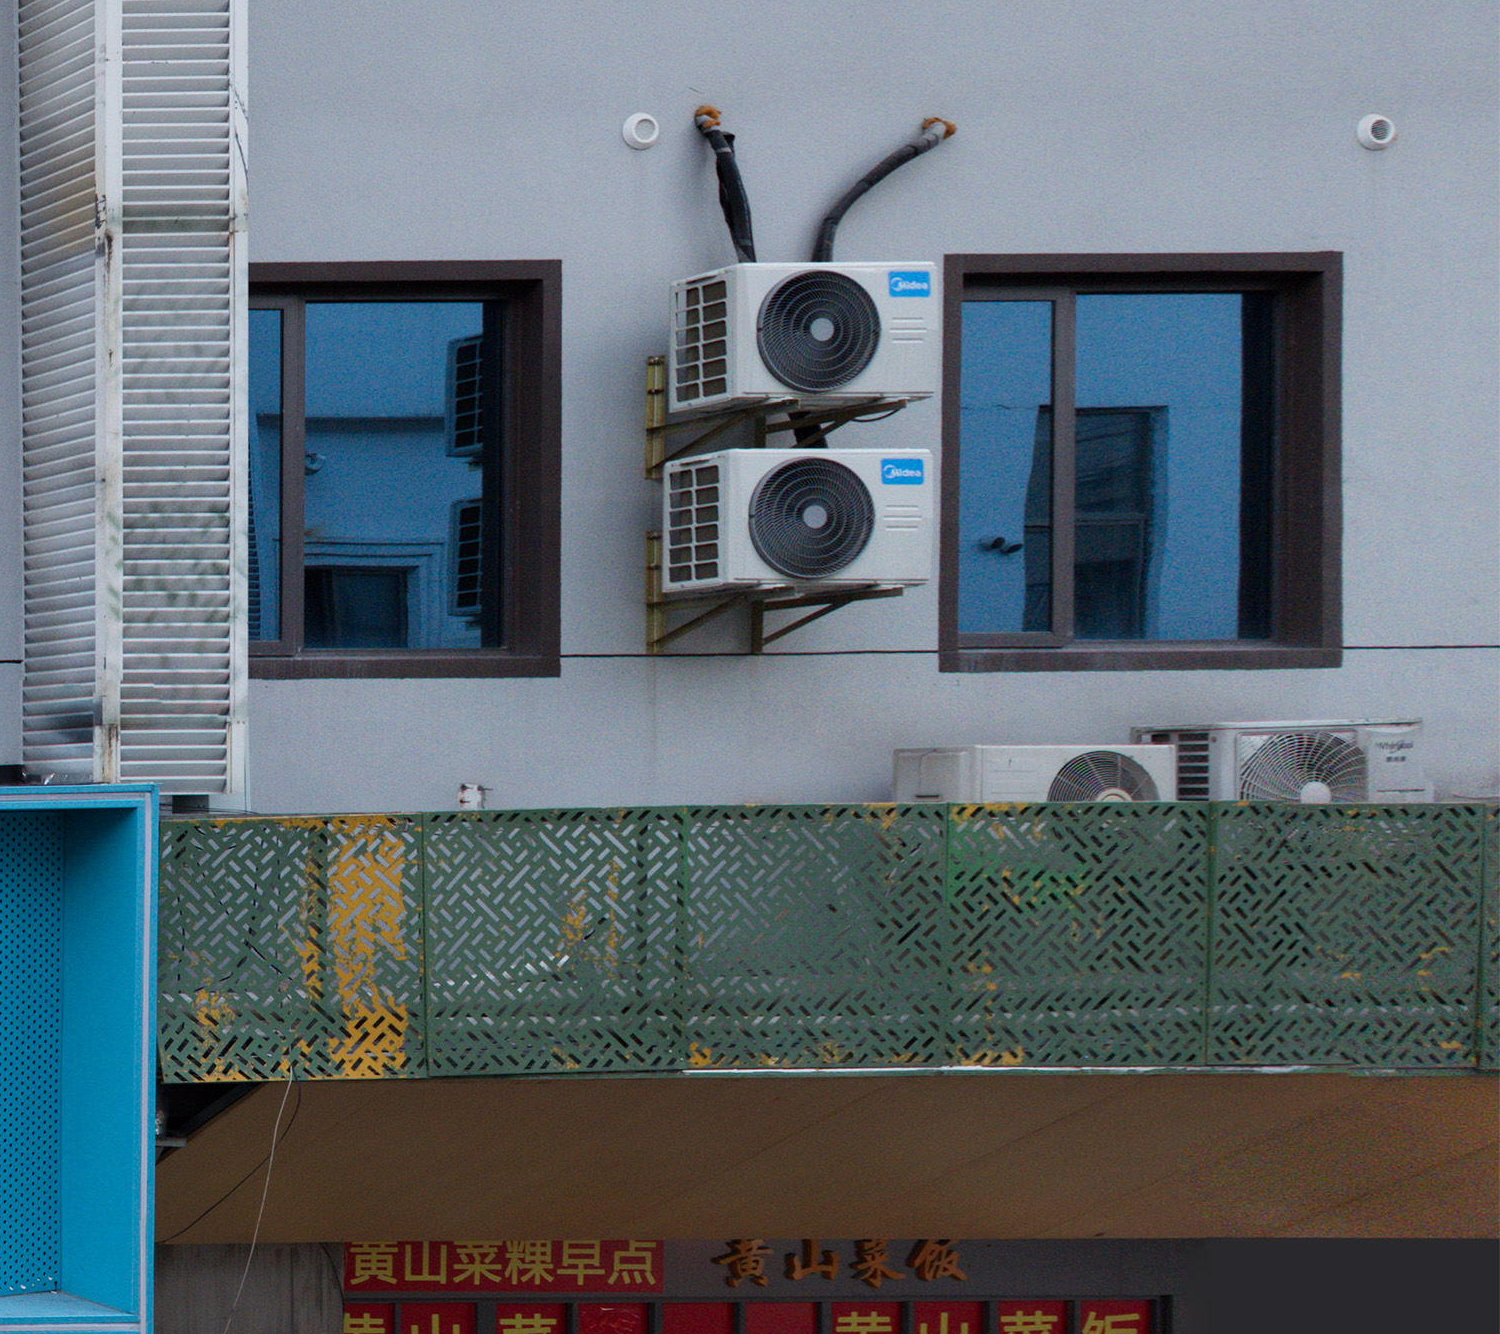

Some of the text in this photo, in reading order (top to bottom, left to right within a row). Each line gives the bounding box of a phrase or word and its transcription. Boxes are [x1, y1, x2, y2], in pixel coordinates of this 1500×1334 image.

[891, 277, 928, 291] Midea
[883, 465, 921, 479] Midea
[350, 1240, 657, 1286] 黄山菜粿早点
[711, 1239, 967, 1288] 黄山菜饭
